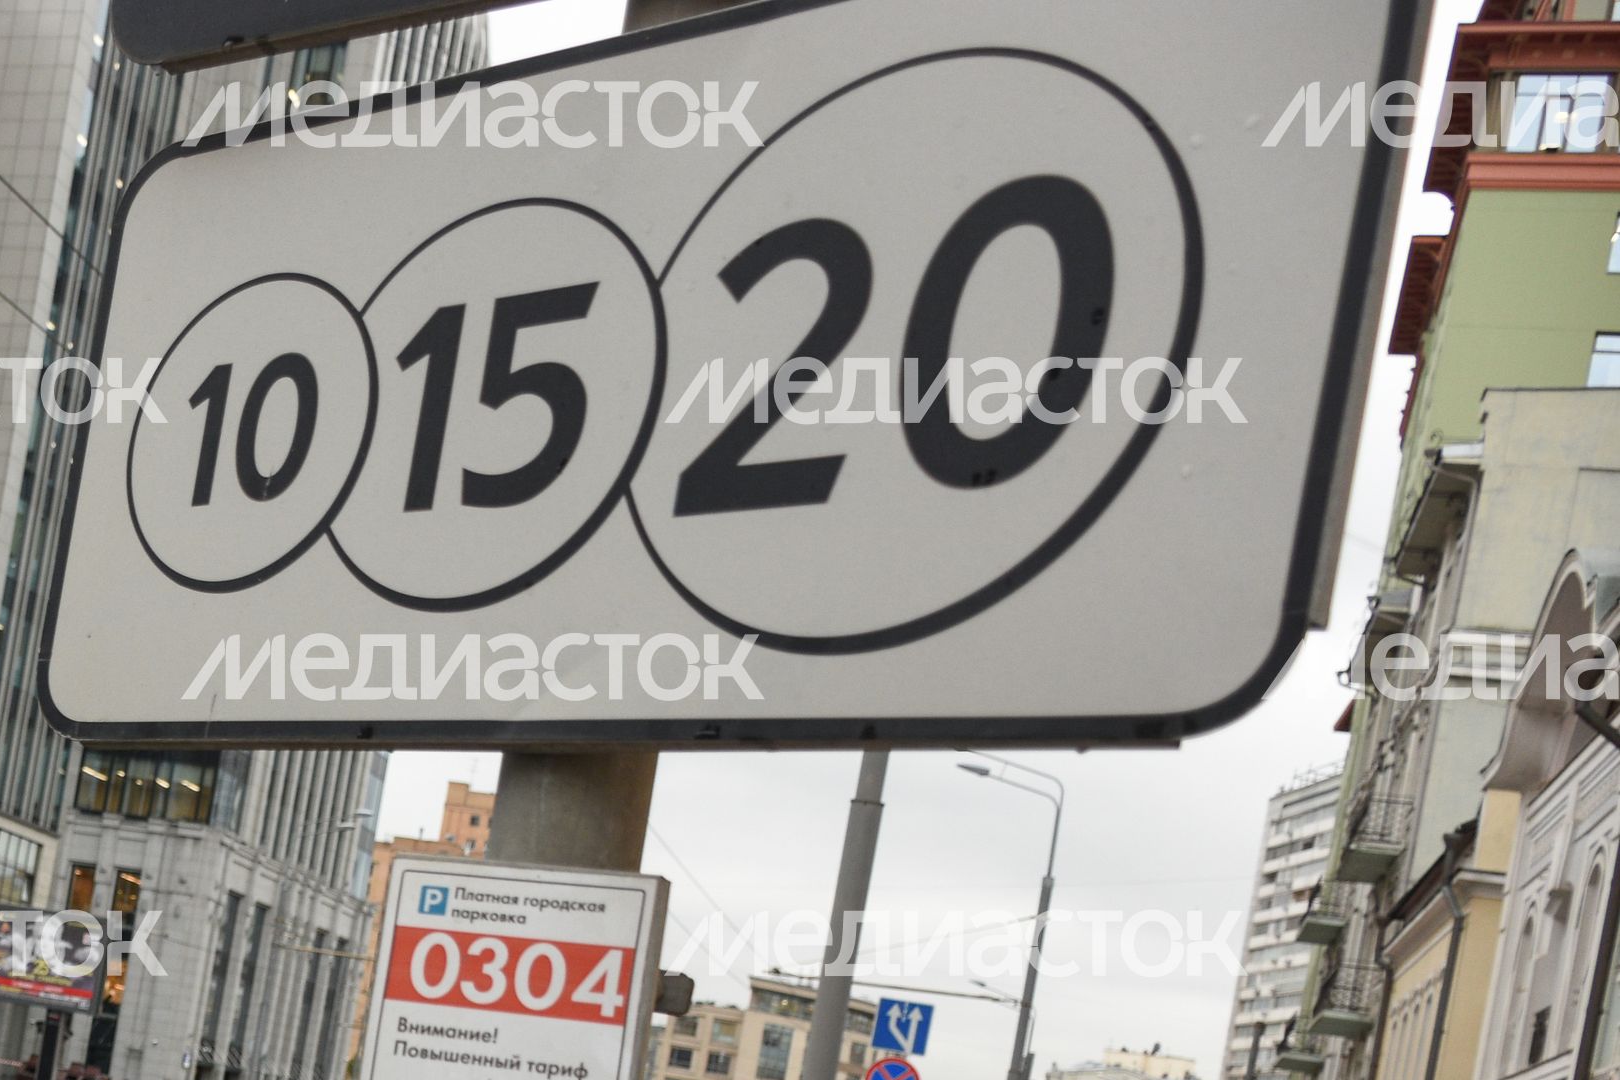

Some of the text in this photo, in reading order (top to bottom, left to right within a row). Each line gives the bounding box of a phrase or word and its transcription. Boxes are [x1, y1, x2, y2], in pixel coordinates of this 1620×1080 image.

[189, 173, 1116, 517] 10 15 20
[452, 887, 605, 916] Платная городская
[449, 909, 525, 928] парковка
[409, 932, 626, 1018] 0304
[397, 1017, 497, 1042] Внимание!
[394, 1040, 519, 1068] Повышенный
